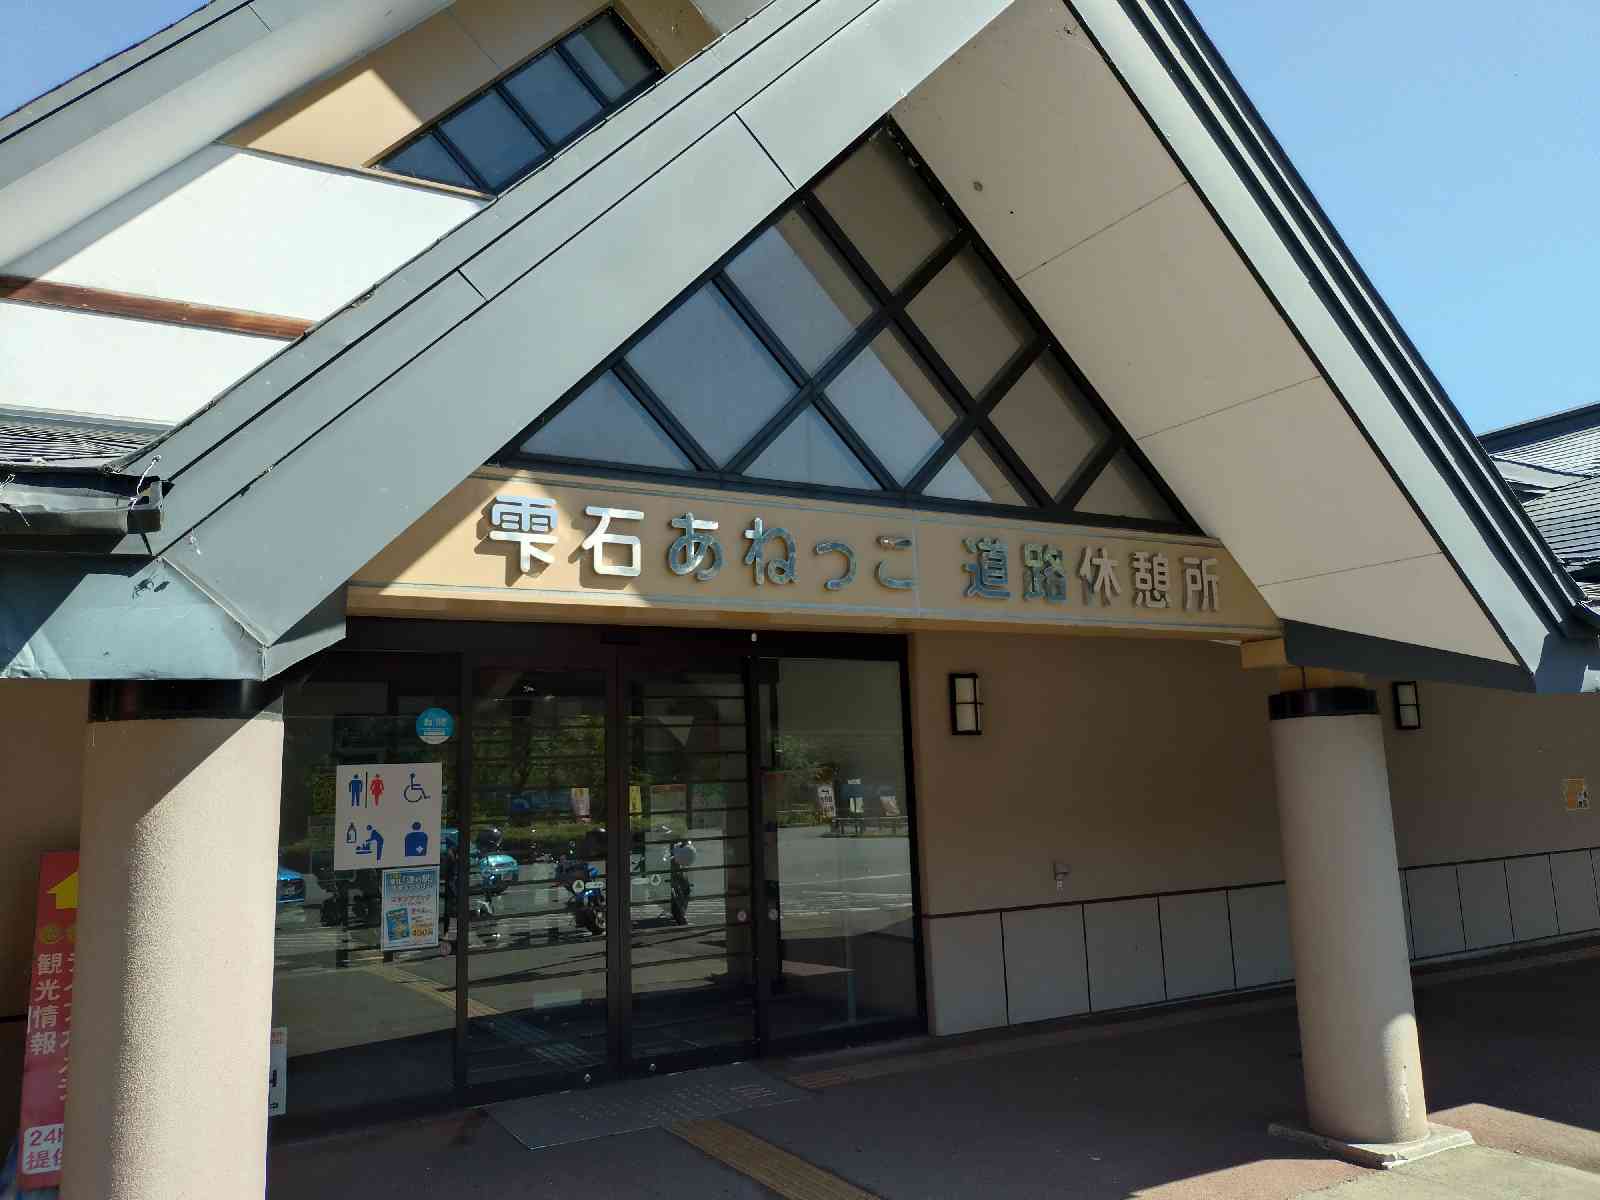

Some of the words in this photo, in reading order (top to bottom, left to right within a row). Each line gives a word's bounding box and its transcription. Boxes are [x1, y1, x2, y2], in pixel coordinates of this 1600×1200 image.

[489, 495, 914, 590] 雫石あねっこ
[961, 536, 1218, 612] 道路休憩所
[30, 953, 63, 1055] 観光情報
